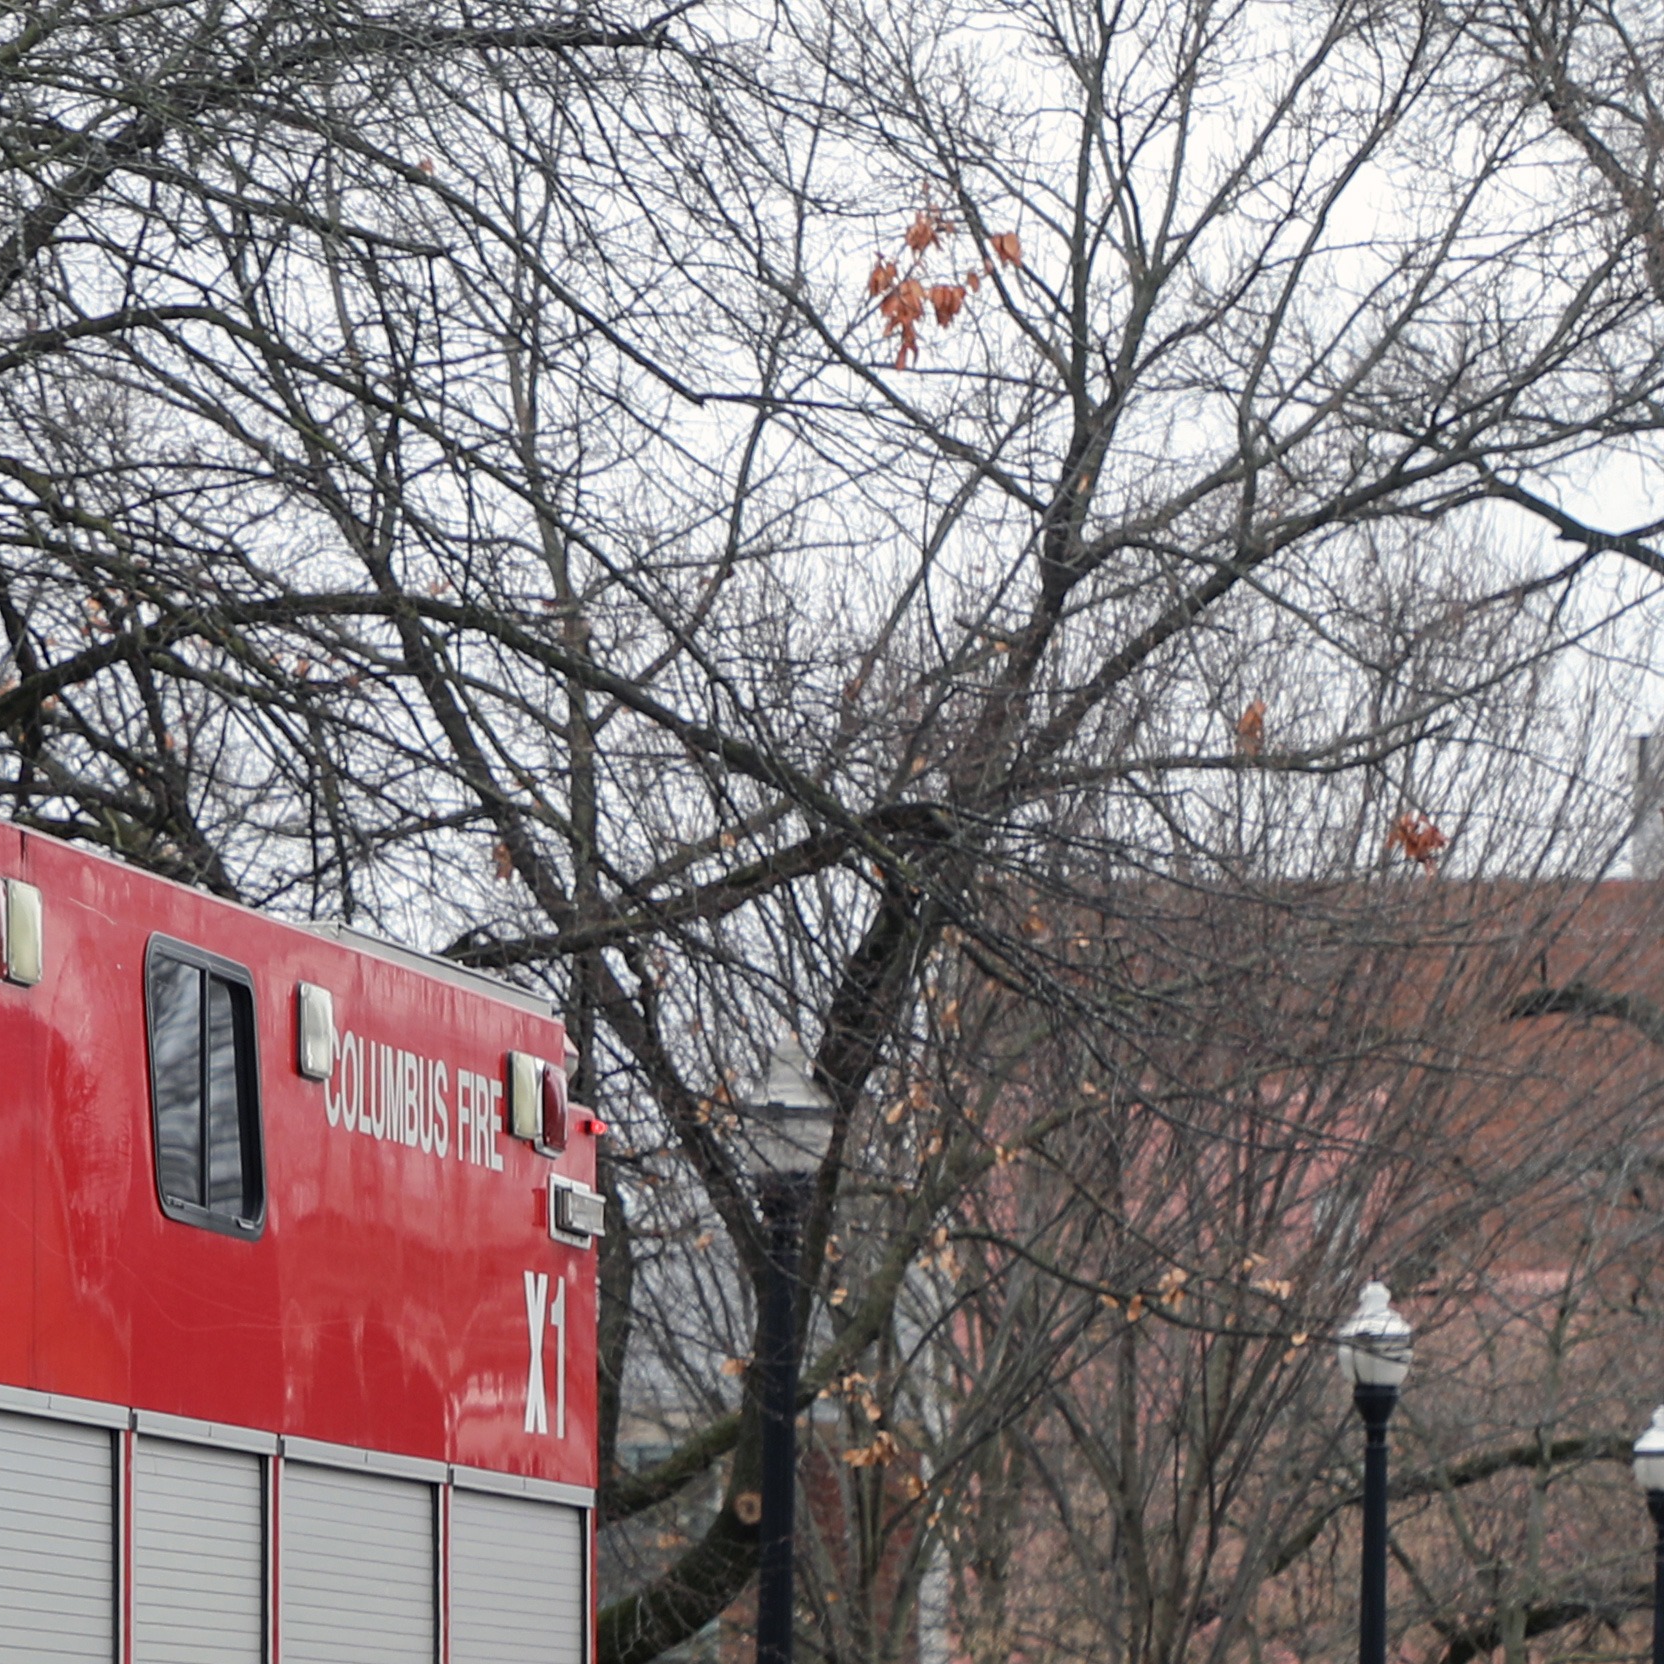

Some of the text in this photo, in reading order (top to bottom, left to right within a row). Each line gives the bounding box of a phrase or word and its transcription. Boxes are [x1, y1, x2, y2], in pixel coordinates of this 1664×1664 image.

[324, 1026, 504, 1173] COLUMBUS FIRE
[523, 1269, 566, 1440] X1
